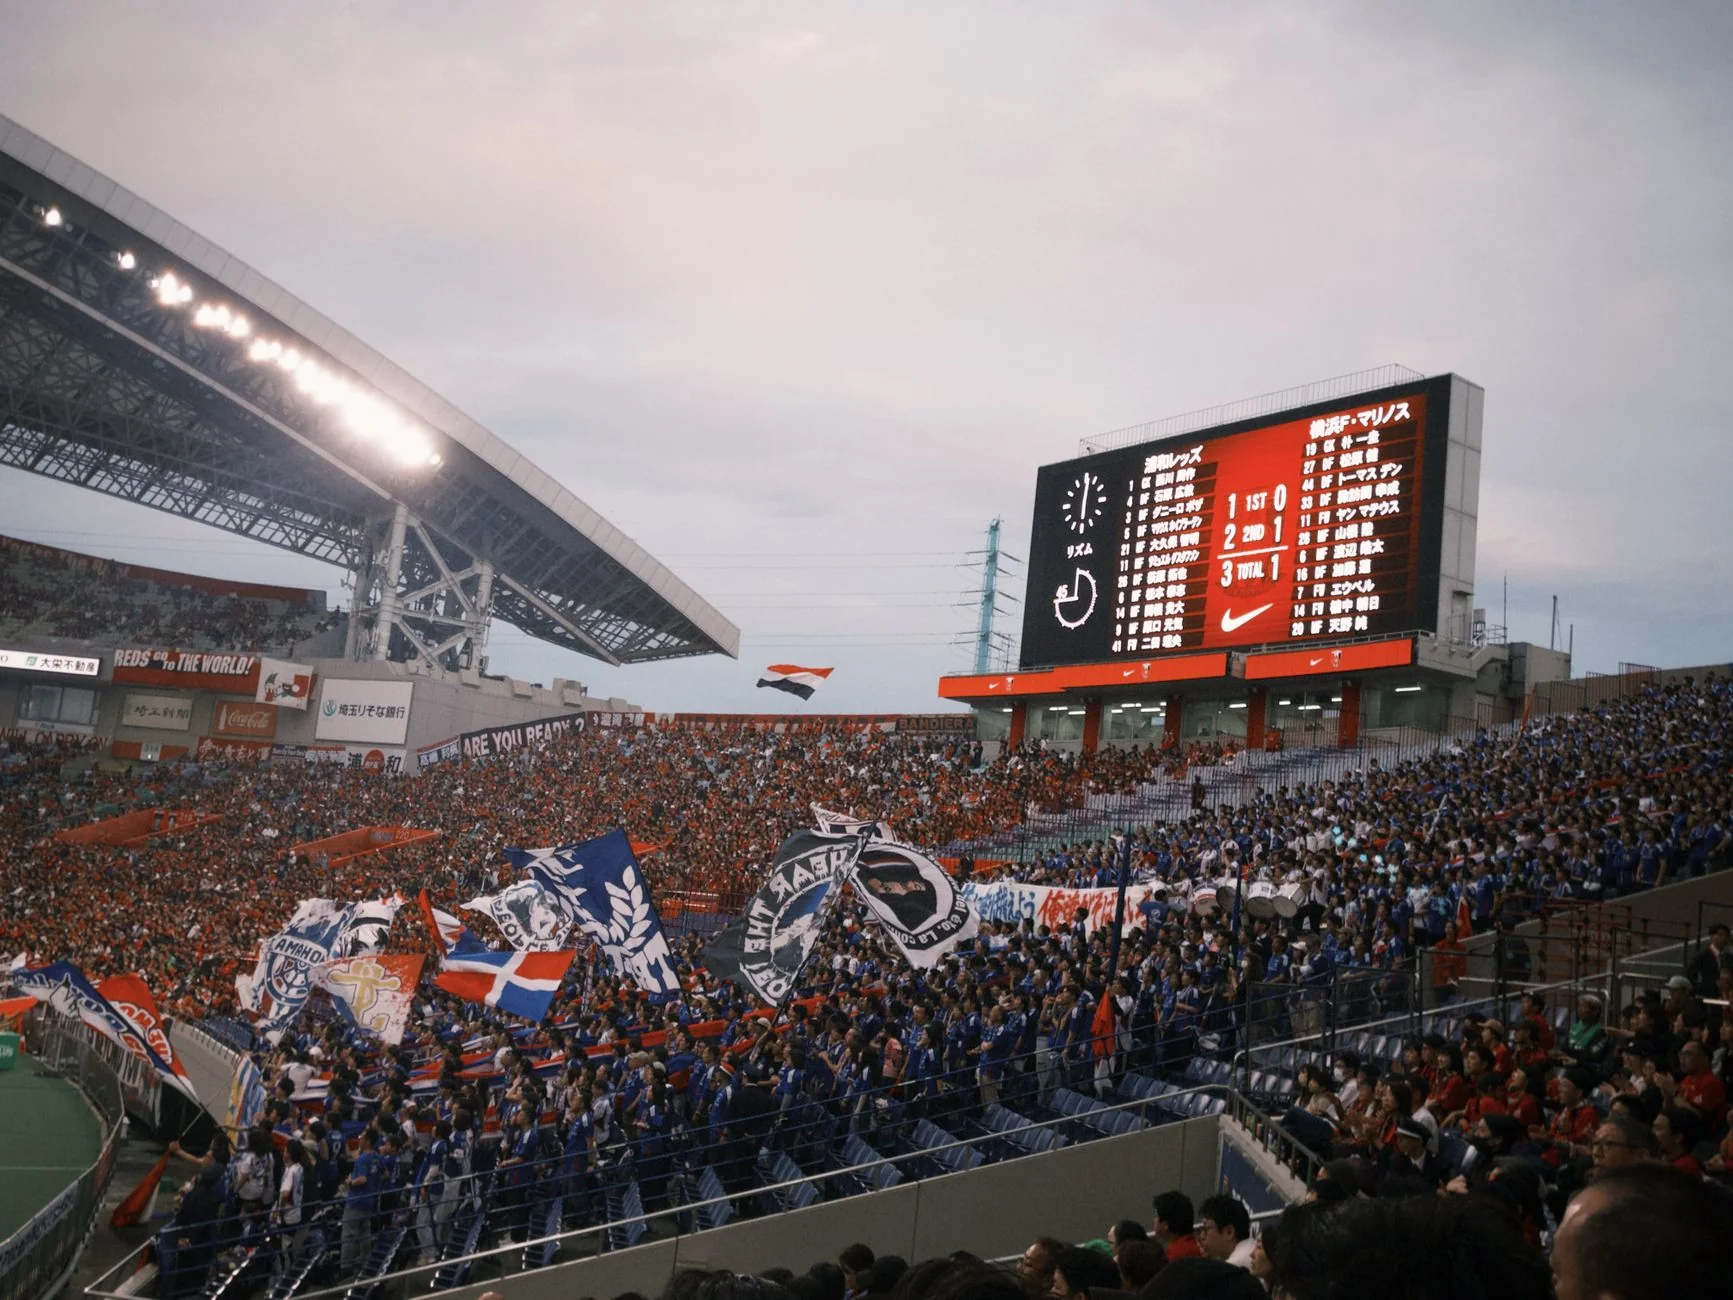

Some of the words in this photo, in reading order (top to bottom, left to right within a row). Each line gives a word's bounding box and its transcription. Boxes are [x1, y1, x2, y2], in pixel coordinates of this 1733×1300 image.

[1306, 443, 1316, 456] 19
[1144, 445, 1203, 474] 浦和レッズ
[1304, 460, 1315, 474] 27
[1302, 478, 1314, 491] 44
[1339, 468, 1376, 486] トーマス
[1379, 463, 1402, 478] デン
[1130, 480, 1133, 491] 1
[1127, 496, 1132, 507] 4
[1229, 494, 1237, 519] 1
[1246, 492, 1267, 511] 1ST
[1274, 484, 1286, 511] 0
[1301, 496, 1312, 509] 33
[1126, 512, 1131, 523] 3
[1153, 503, 1184, 519] ダニーロ
[1301, 514, 1310, 527] 11
[1336, 508, 1356, 522] ヤン
[1359, 500, 1399, 517] マテウス
[1124, 528, 1130, 539] 5
[1224, 524, 1236, 550] 2
[1242, 524, 1264, 542] 2ND
[1274, 516, 1282, 543] 1
[1068, 543, 1092, 558] リズム
[1121, 544, 1130, 556] 21
[1300, 550, 1306, 563] 6
[1120, 560, 1128, 571] 11
[1221, 559, 1233, 587] 3
[1237, 561, 1264, 580] TOTAL
[1270, 553, 1280, 580] 1
[1297, 568, 1308, 581] 16
[1056, 585, 1068, 599] 45
[1119, 592, 1124, 604] 6
[1298, 587, 1304, 599] 7
[1116, 607, 1125, 619] 14
[1294, 604, 1305, 617] 14
[1292, 622, 1304, 636] 20
[1112, 640, 1121, 652] 41
[40, 658, 96, 673] 大栄不動産
[114, 649, 150, 667] REDS
[153, 651, 168, 661] GO
[162, 660, 175, 671] TO
[177, 653, 200, 673] THE
[201, 655, 254, 675] WORLD!
[338, 704, 405, 719] 埼玉りそな銀行
[464, 733, 490, 756] ARE
[492, 728, 522, 751] YOU
[386, 755, 402, 772] 和
